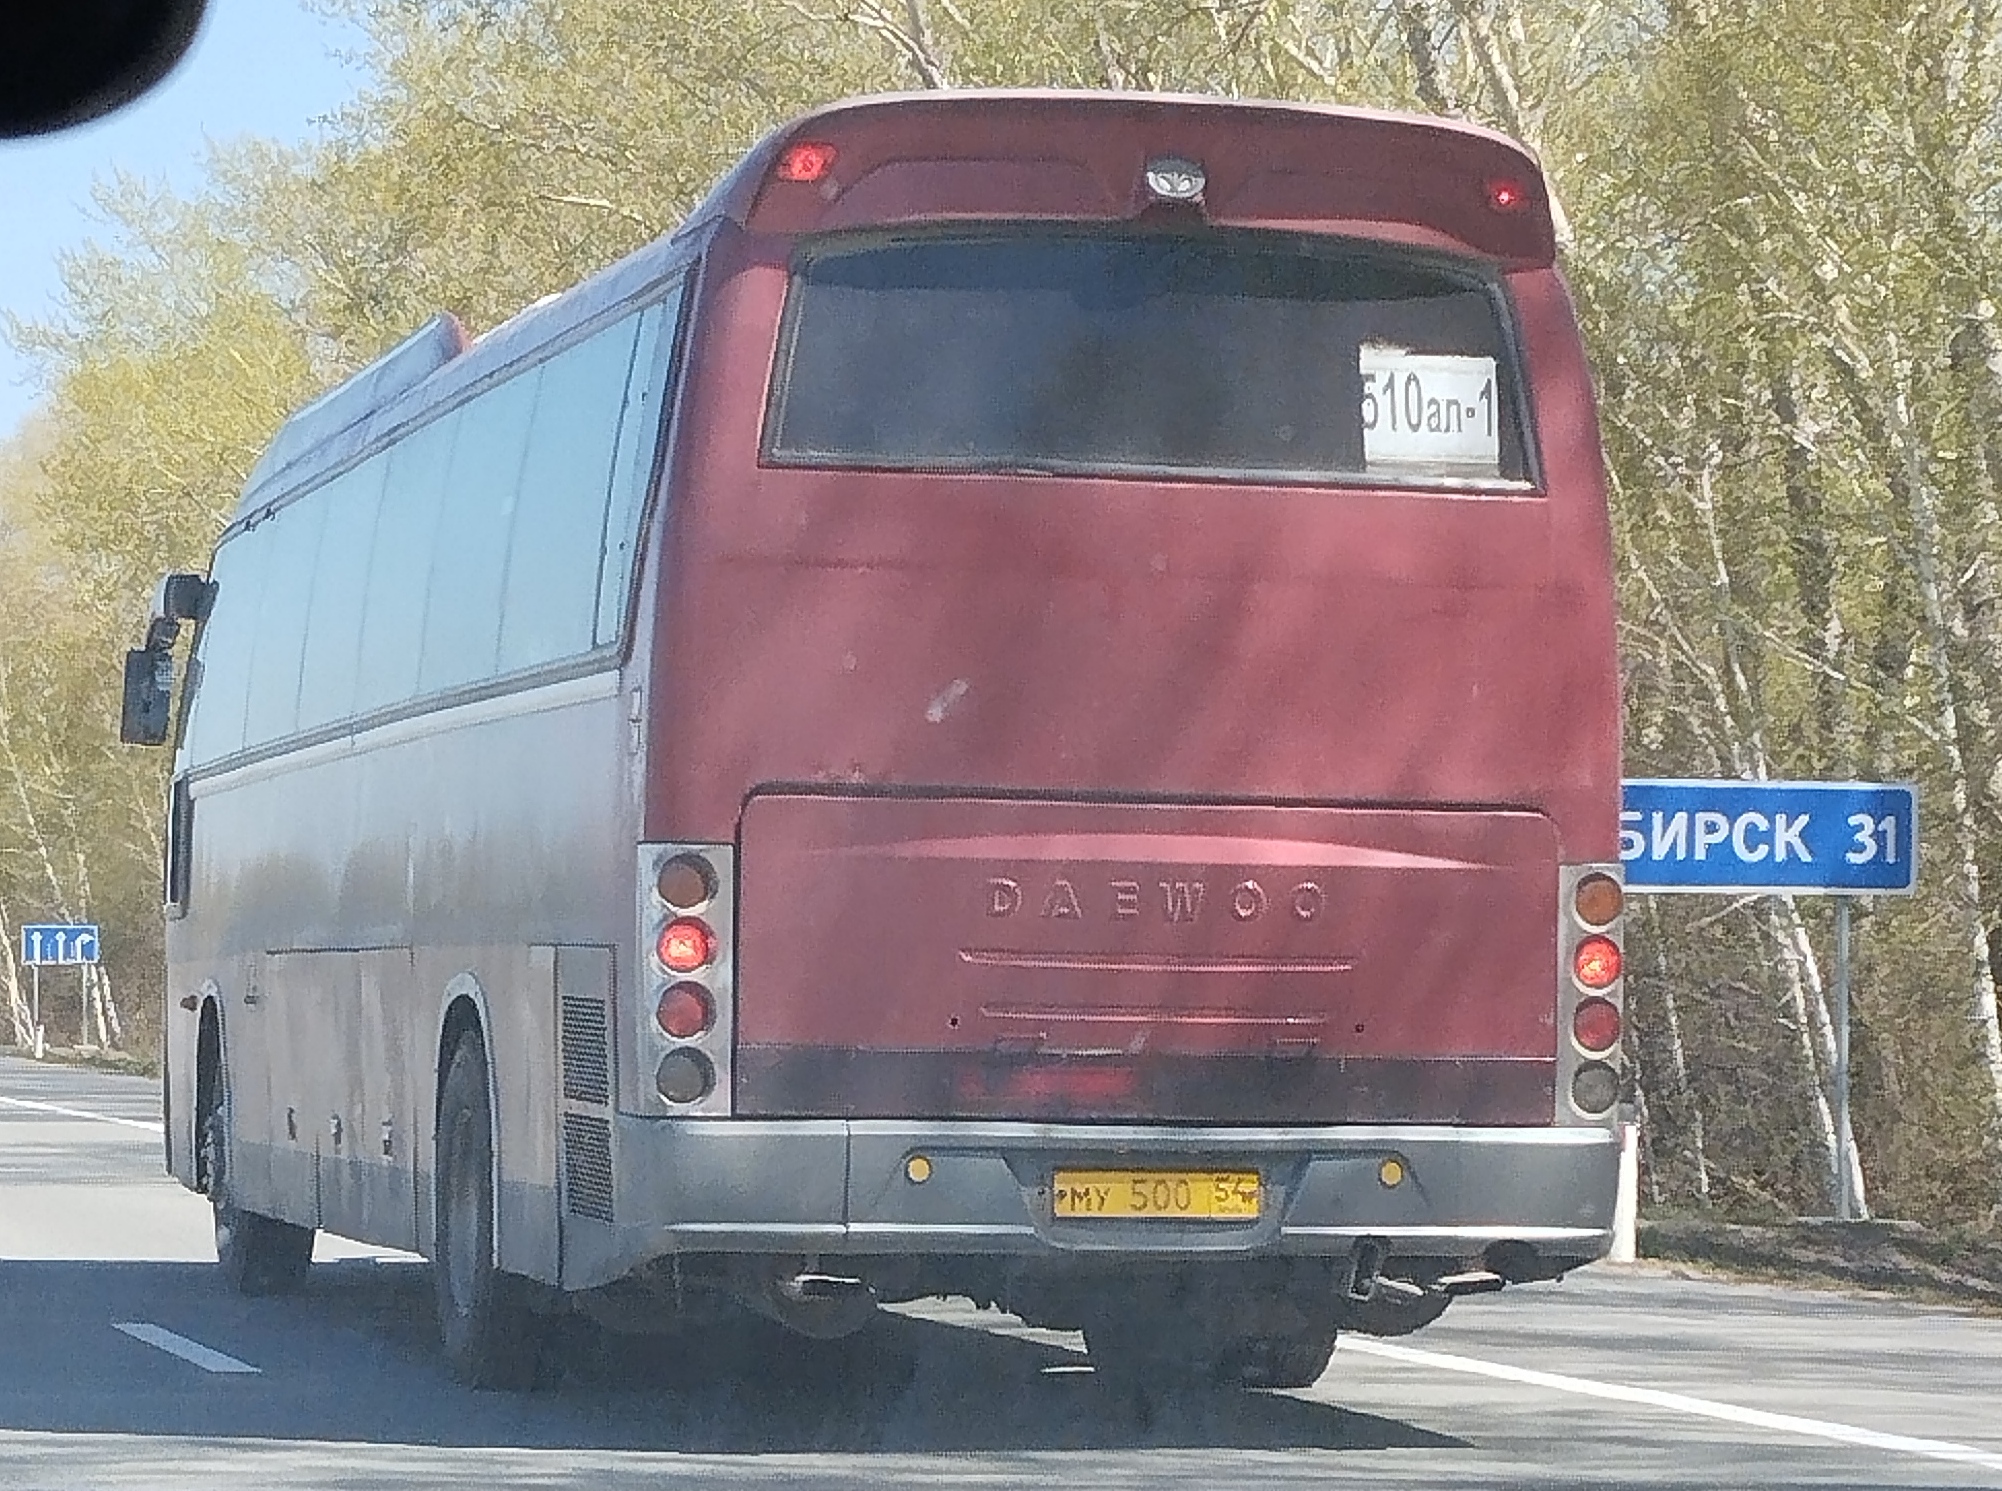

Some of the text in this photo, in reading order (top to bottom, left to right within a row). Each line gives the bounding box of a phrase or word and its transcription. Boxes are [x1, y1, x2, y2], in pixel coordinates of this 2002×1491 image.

[1846, 813, 1897, 864] 31
[985, 877, 1326, 922] DAEWOO
[1130, 1178, 1192, 1212] 500
